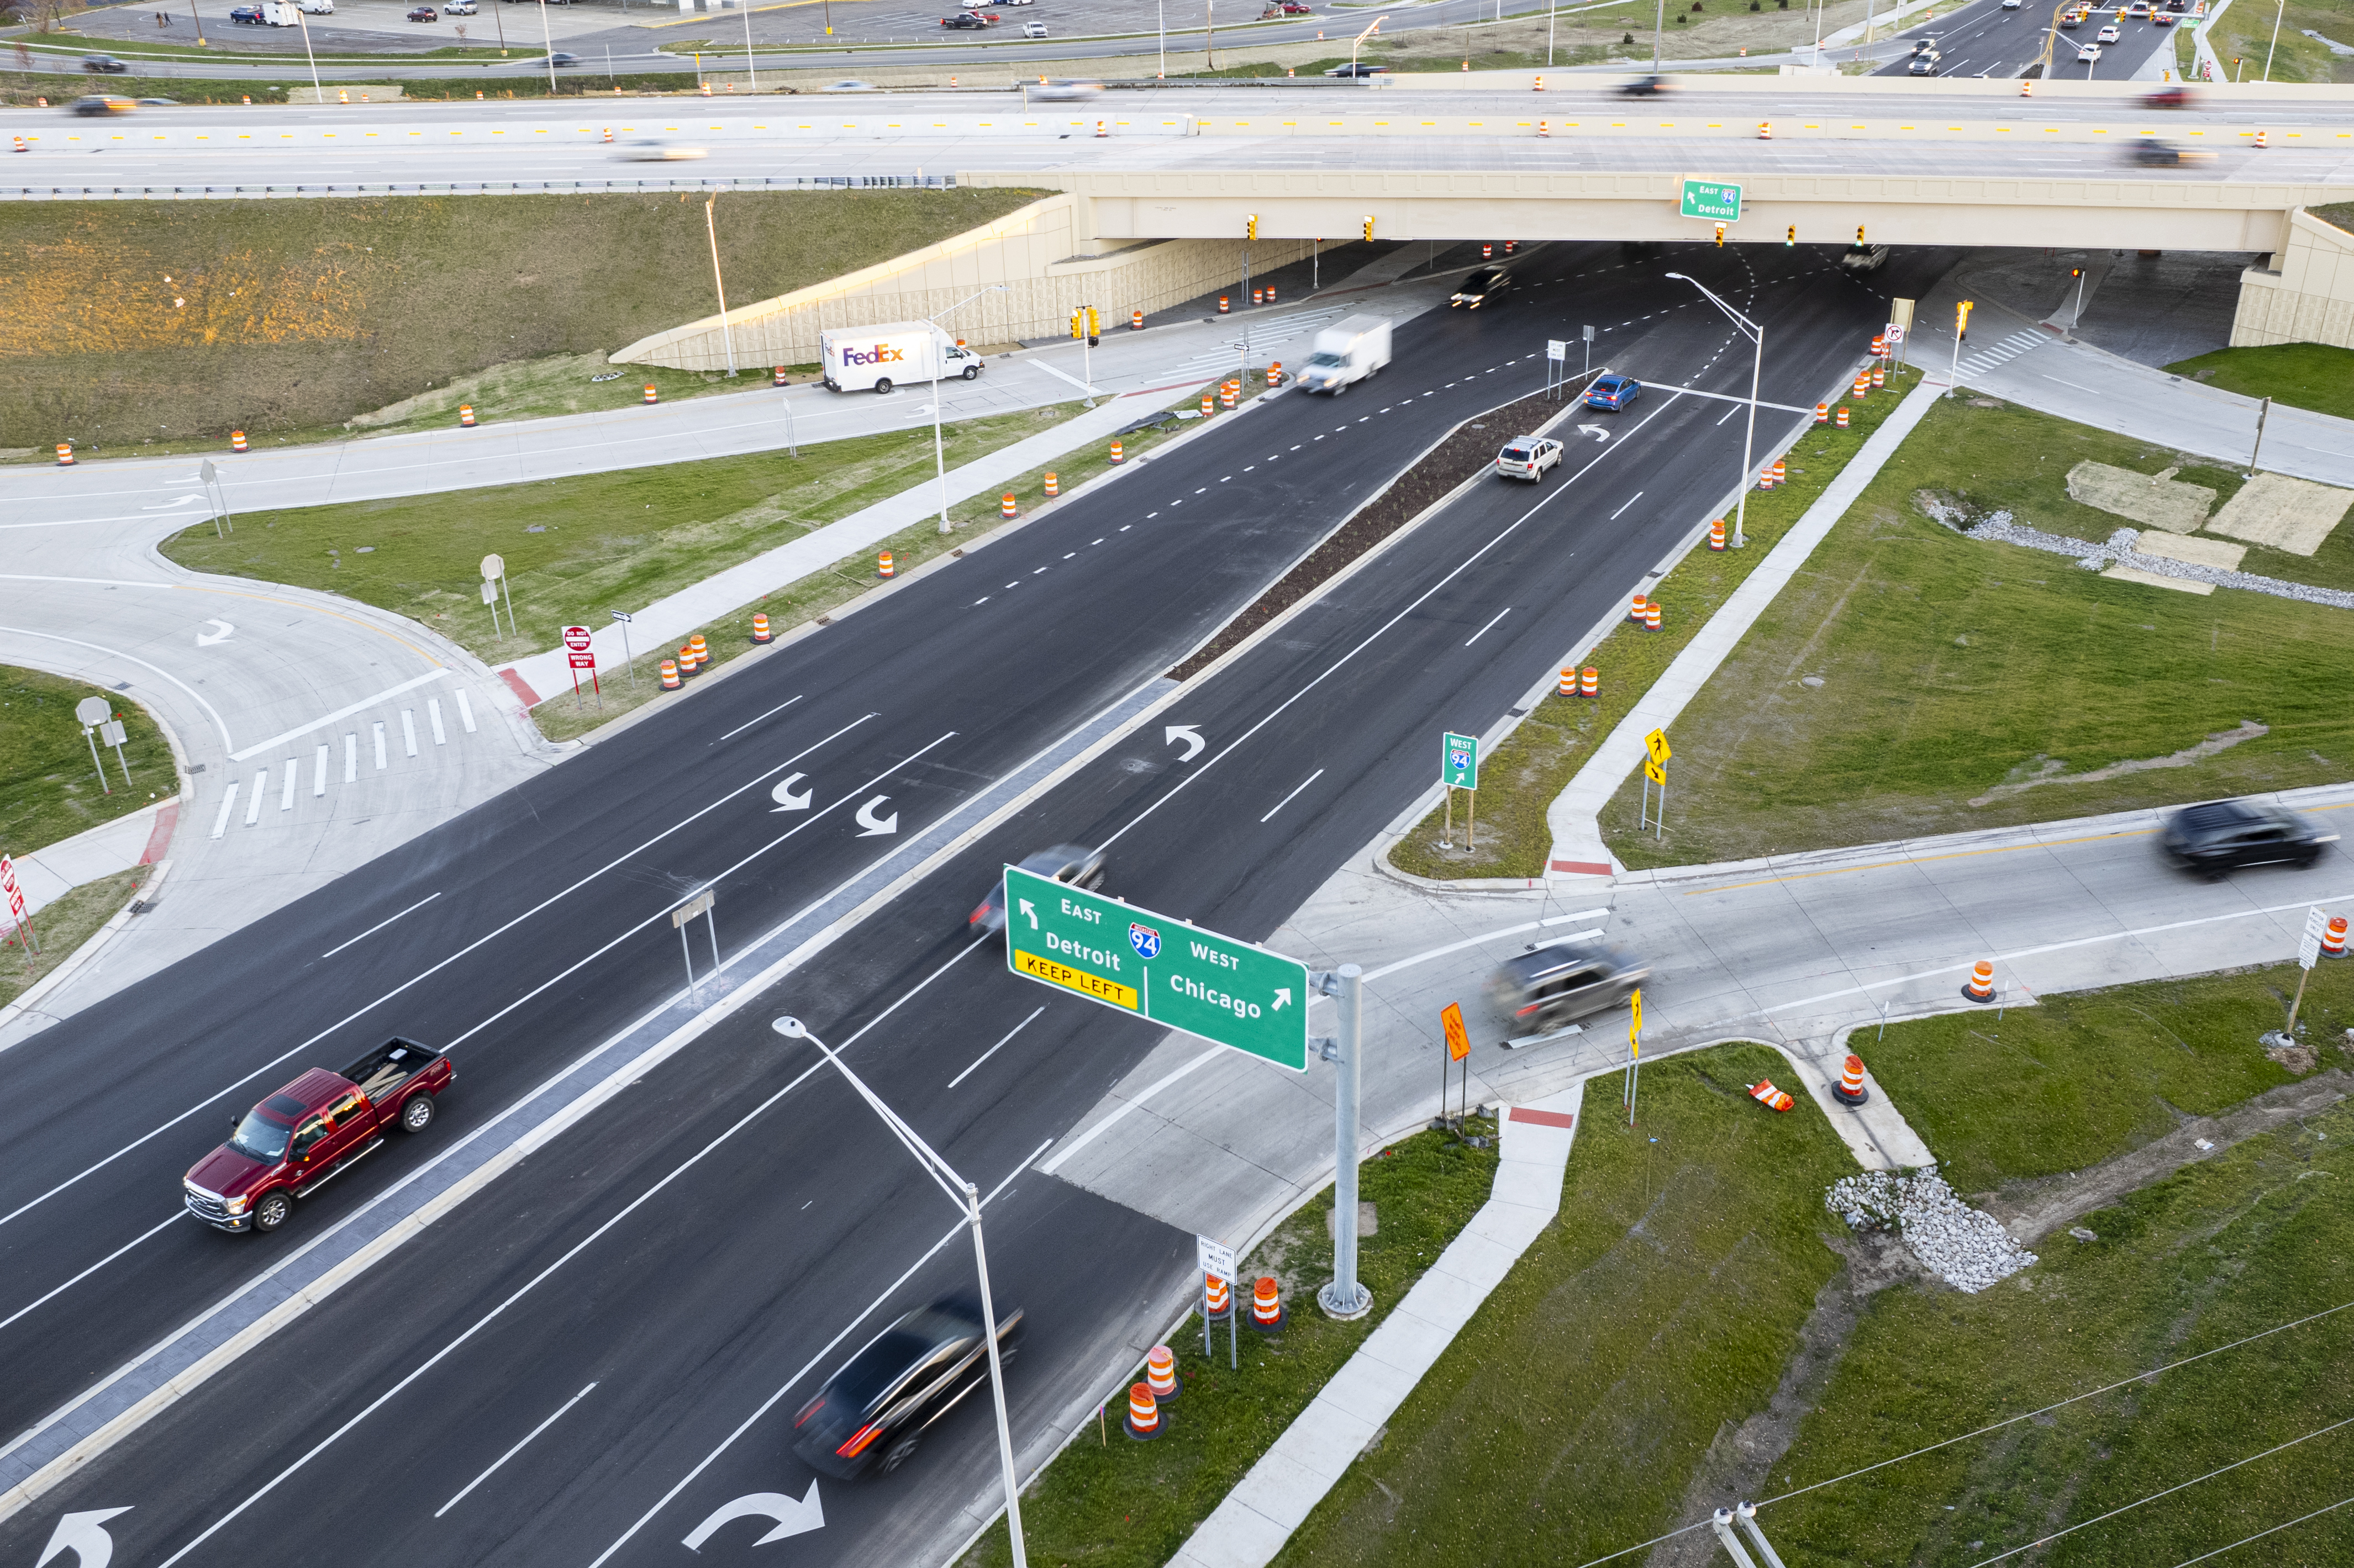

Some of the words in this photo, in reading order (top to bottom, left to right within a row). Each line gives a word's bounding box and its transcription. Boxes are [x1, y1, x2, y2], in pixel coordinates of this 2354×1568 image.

[1699, 186, 1718, 194] EAST
[1723, 192, 1734, 201] 94
[1698, 204, 1734, 216] Detroit
[843, 343, 904, 367] FedEx
[1450, 737, 1472, 749] WEST
[1452, 754, 1467, 767] 94
[1061, 898, 1102, 925] EAST
[2312, 911, 2324, 921] MOTOR
[2309, 917, 2324, 929] VEHICLES
[2310, 924, 2319, 932] ONLY
[1134, 925, 1155, 936] INTERSTATE
[1131, 931, 1156, 955] 94
[1046, 932, 1120, 971] Detroit
[1191, 941, 1239, 970] WEST
[1028, 957, 1072, 981] KEEP
[1081, 974, 1123, 1000] LEFT
[1170, 974, 1261, 1018] Chicago
[1450, 1013, 1461, 1030] RAMP
[1200, 1240, 1215, 1251] RIGHT
[1219, 1249, 1233, 1259] LANE
[1208, 1254, 1225, 1265] MUST
[1203, 1261, 1213, 1270] USE
[1217, 1267, 1231, 1277] RAMP
